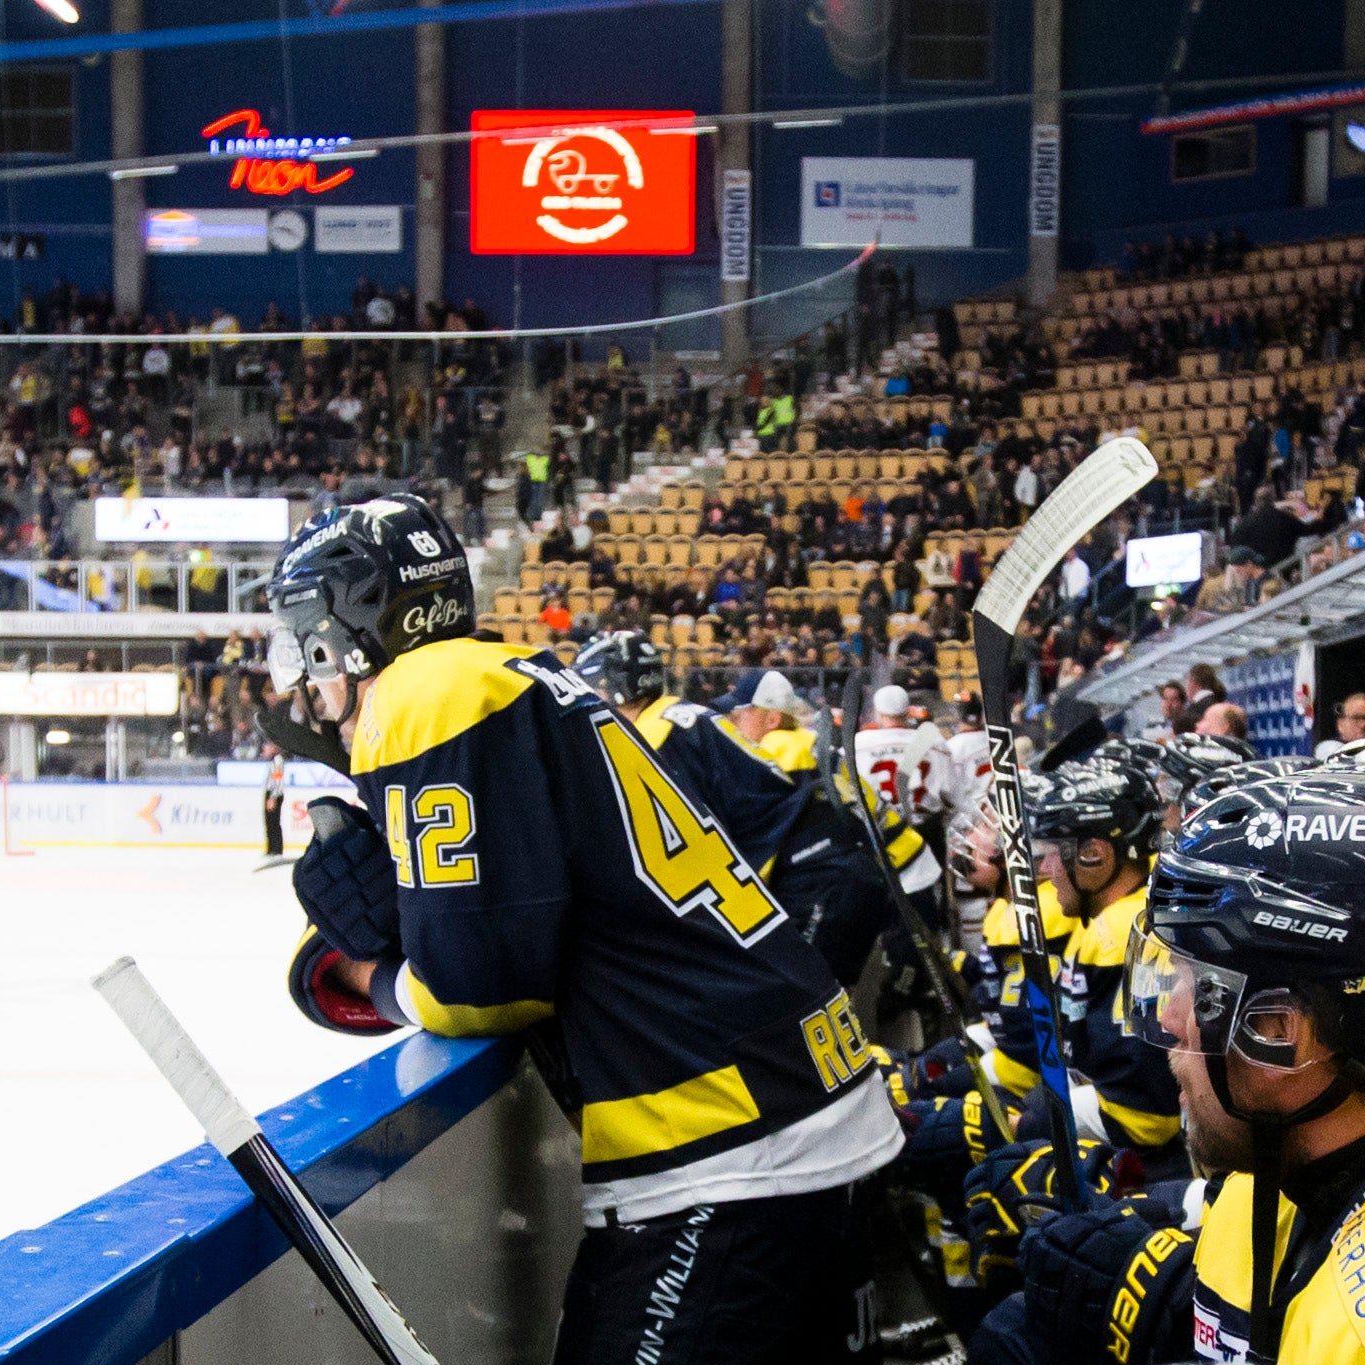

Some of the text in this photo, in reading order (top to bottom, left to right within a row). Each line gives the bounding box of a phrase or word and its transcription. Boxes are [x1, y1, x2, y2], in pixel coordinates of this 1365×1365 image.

[1035, 141, 1059, 231] UNGDOM
[725, 186, 749, 276] UNGDOM
[399, 556, 466, 583] Husqvarna
[343, 650, 370, 676] 42
[171, 803, 233, 825] Kitron
[384, 784, 481, 889] 42
[1253, 910, 1349, 943] BAUER
